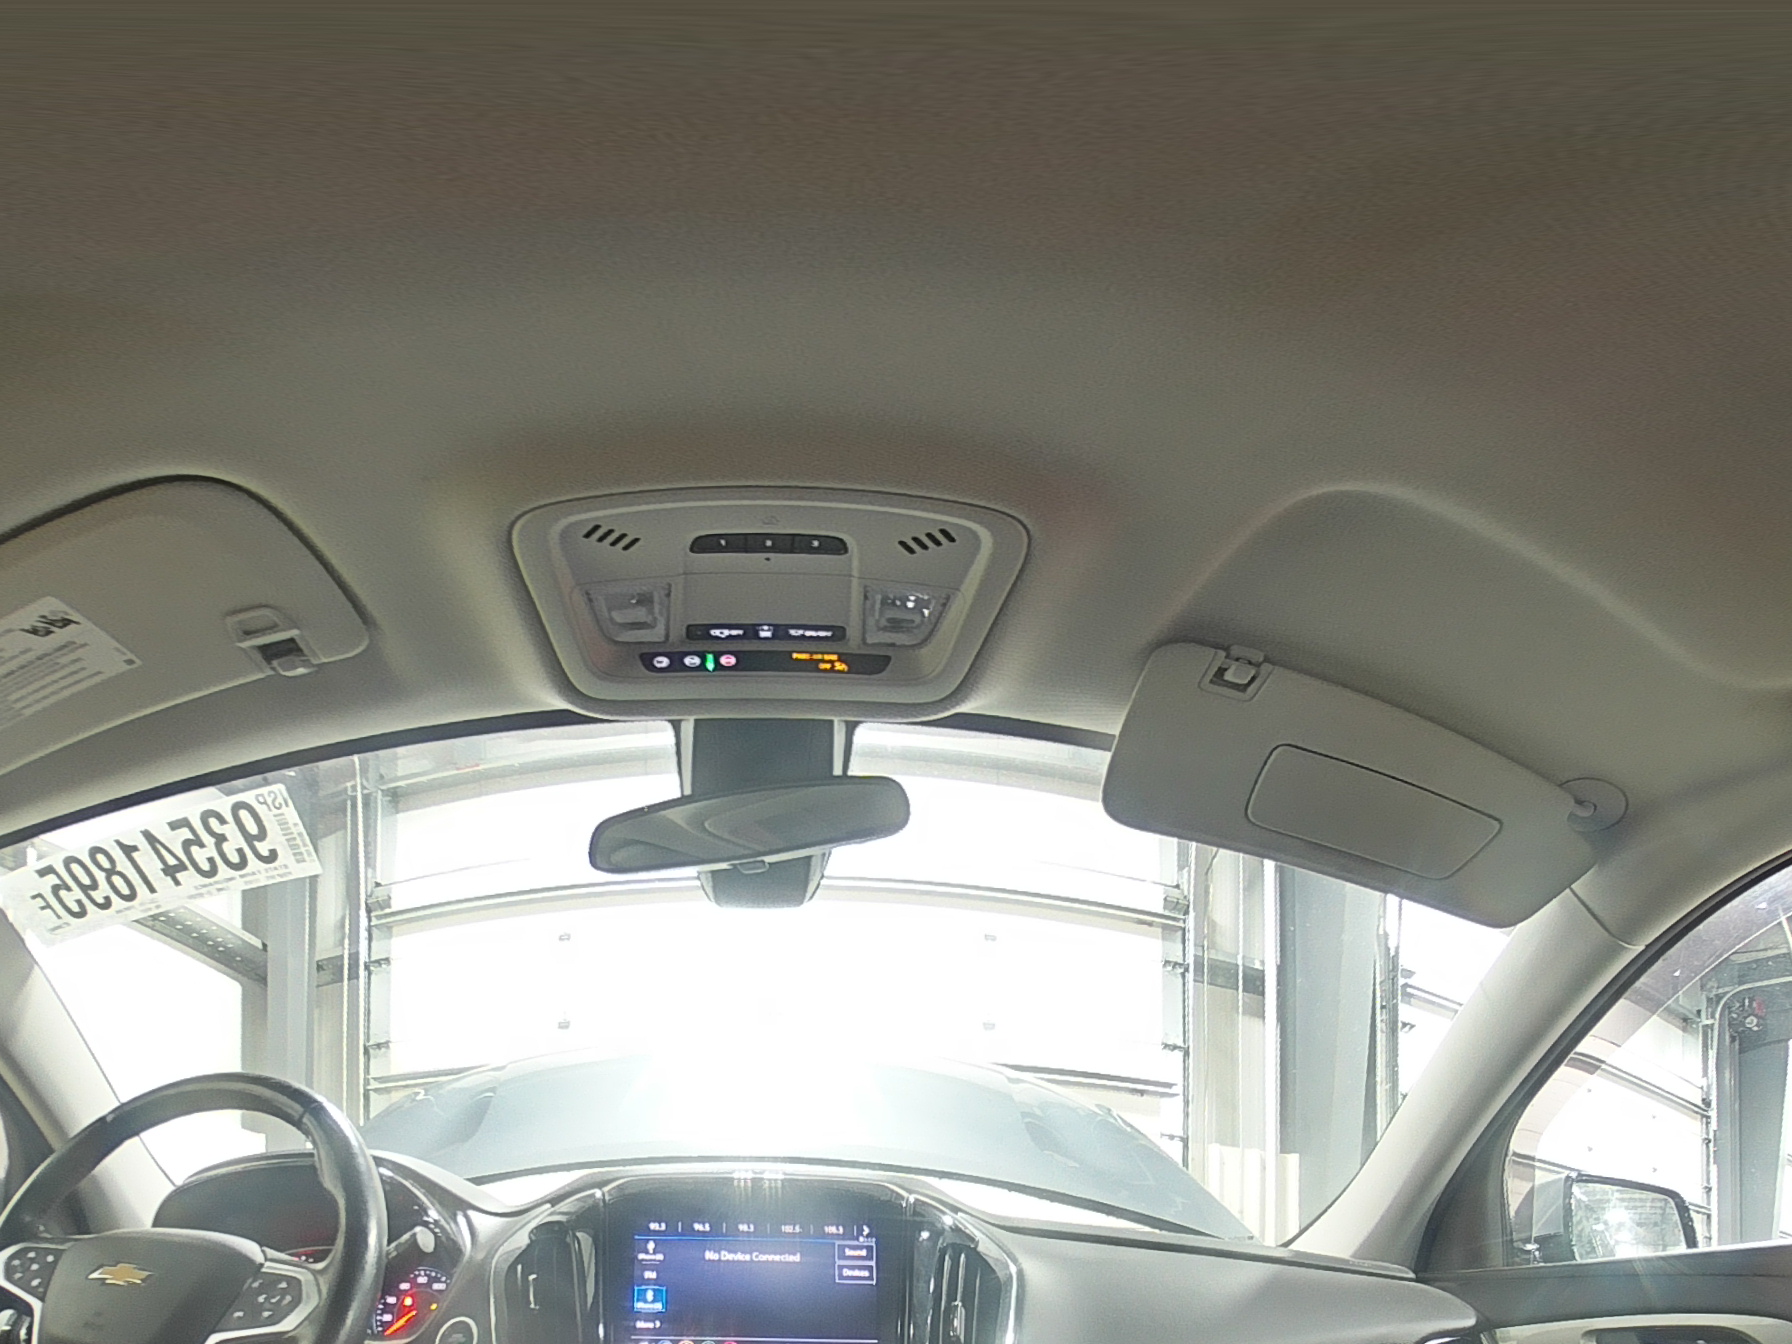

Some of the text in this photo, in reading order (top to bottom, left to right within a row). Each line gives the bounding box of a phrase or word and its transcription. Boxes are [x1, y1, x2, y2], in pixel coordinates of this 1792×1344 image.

[705, 1251, 801, 1263] No Device Connected
[844, 1247, 867, 1258] Sound
[842, 1268, 870, 1278] Devices
